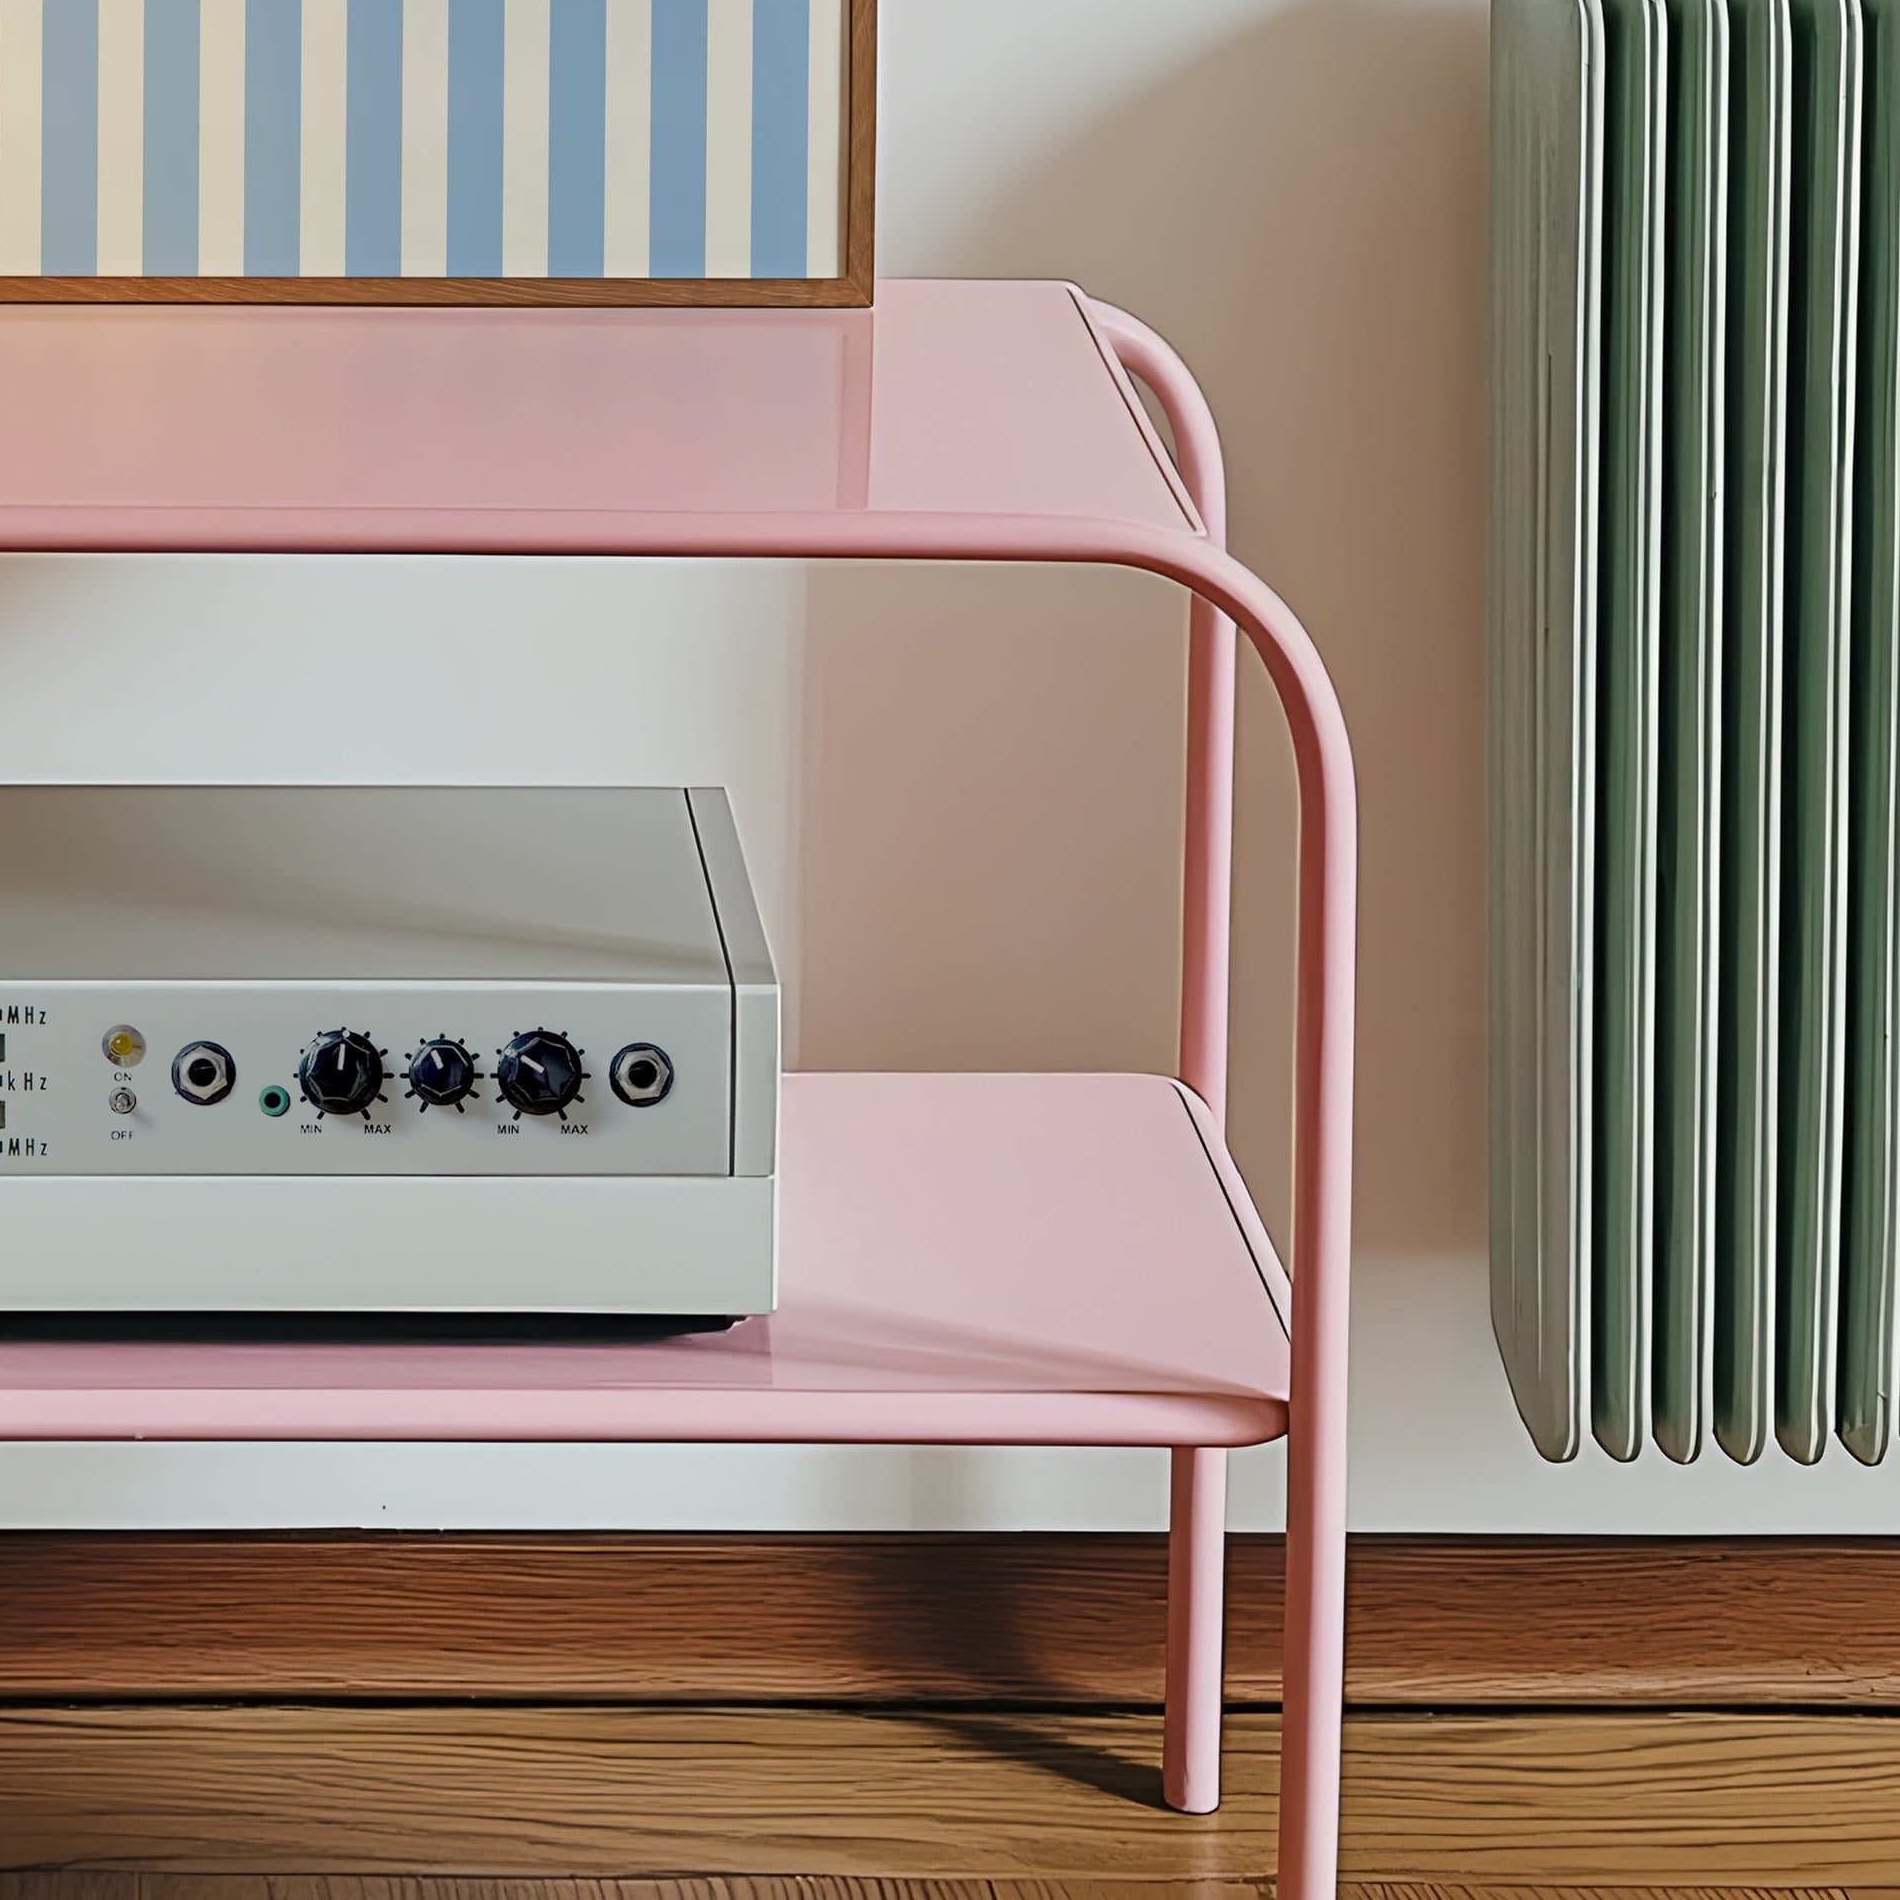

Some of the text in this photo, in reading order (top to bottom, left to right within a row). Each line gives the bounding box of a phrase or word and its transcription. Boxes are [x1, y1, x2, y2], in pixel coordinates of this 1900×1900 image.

[7, 1006, 47, 1025] MHz
[7, 1070, 47, 1091] kHz
[113, 1072, 132, 1082] ON
[300, 1124, 392, 1134] MIN MAX
[497, 1124, 588, 1134] MIN MAX
[110, 1130, 135, 1141] OFF
[8, 1138, 48, 1156] MHz
